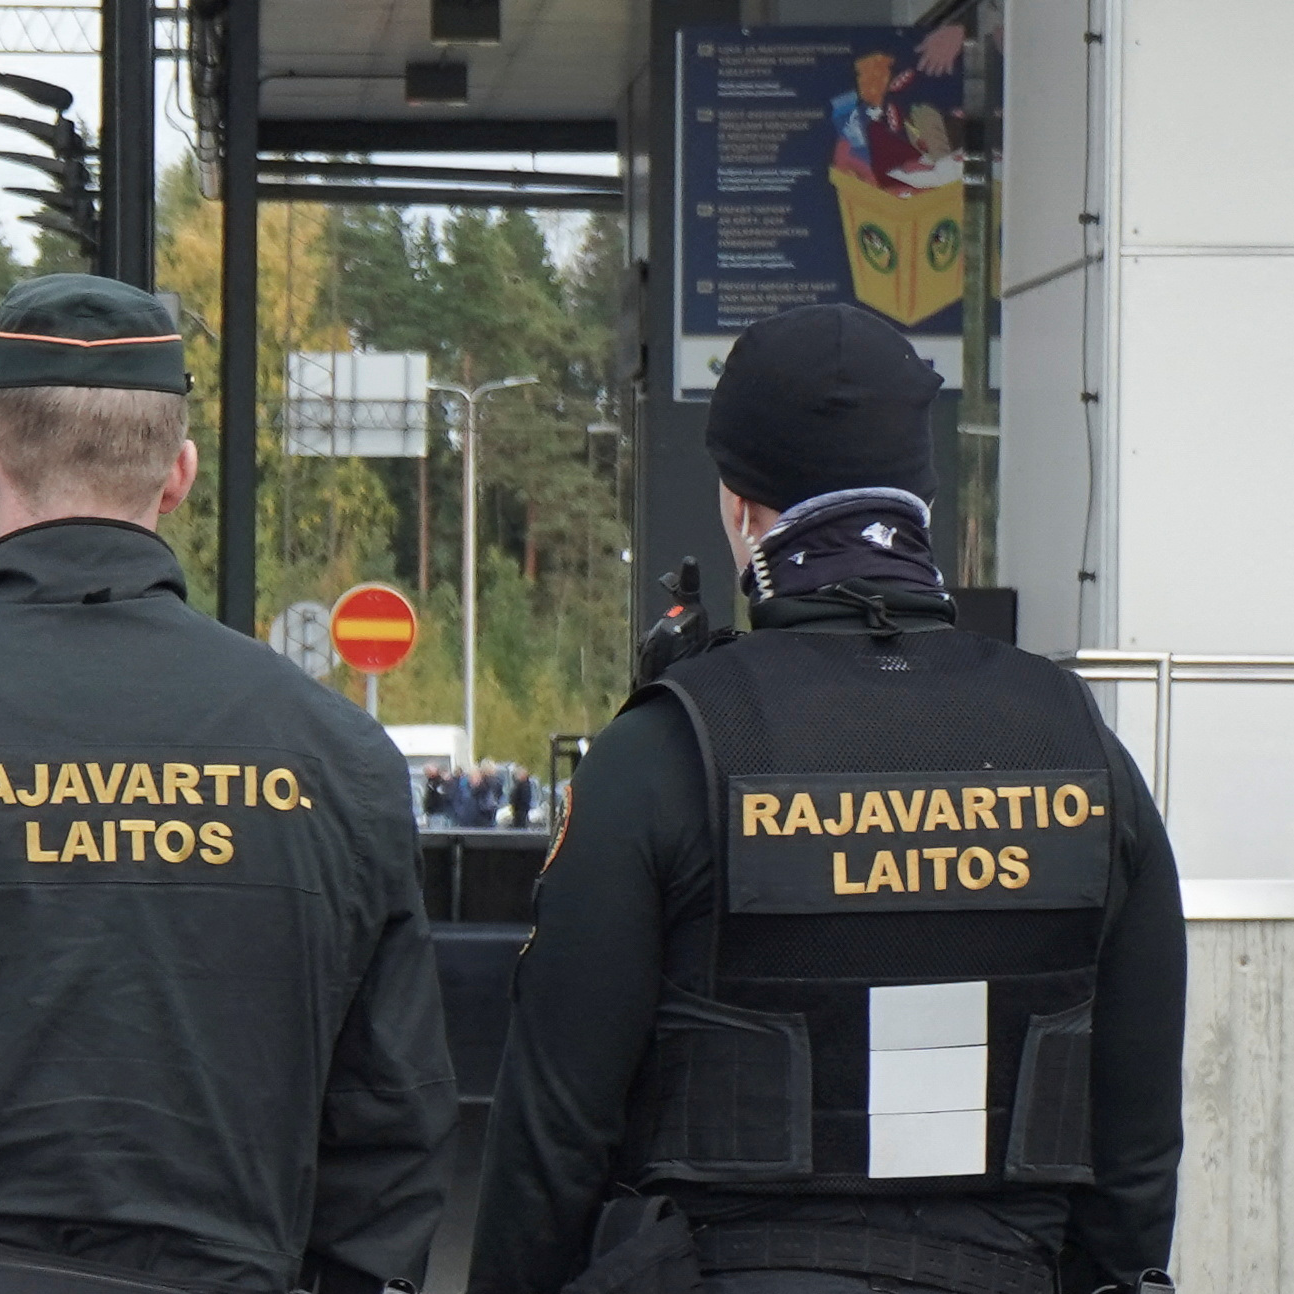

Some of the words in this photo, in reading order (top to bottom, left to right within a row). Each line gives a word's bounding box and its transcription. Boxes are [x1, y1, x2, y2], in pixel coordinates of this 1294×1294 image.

[743, 784, 1105, 836] RAJAVARTIO-
[26, 820, 234, 864] LAITOS
[833, 846, 1030, 894] LAITOS
